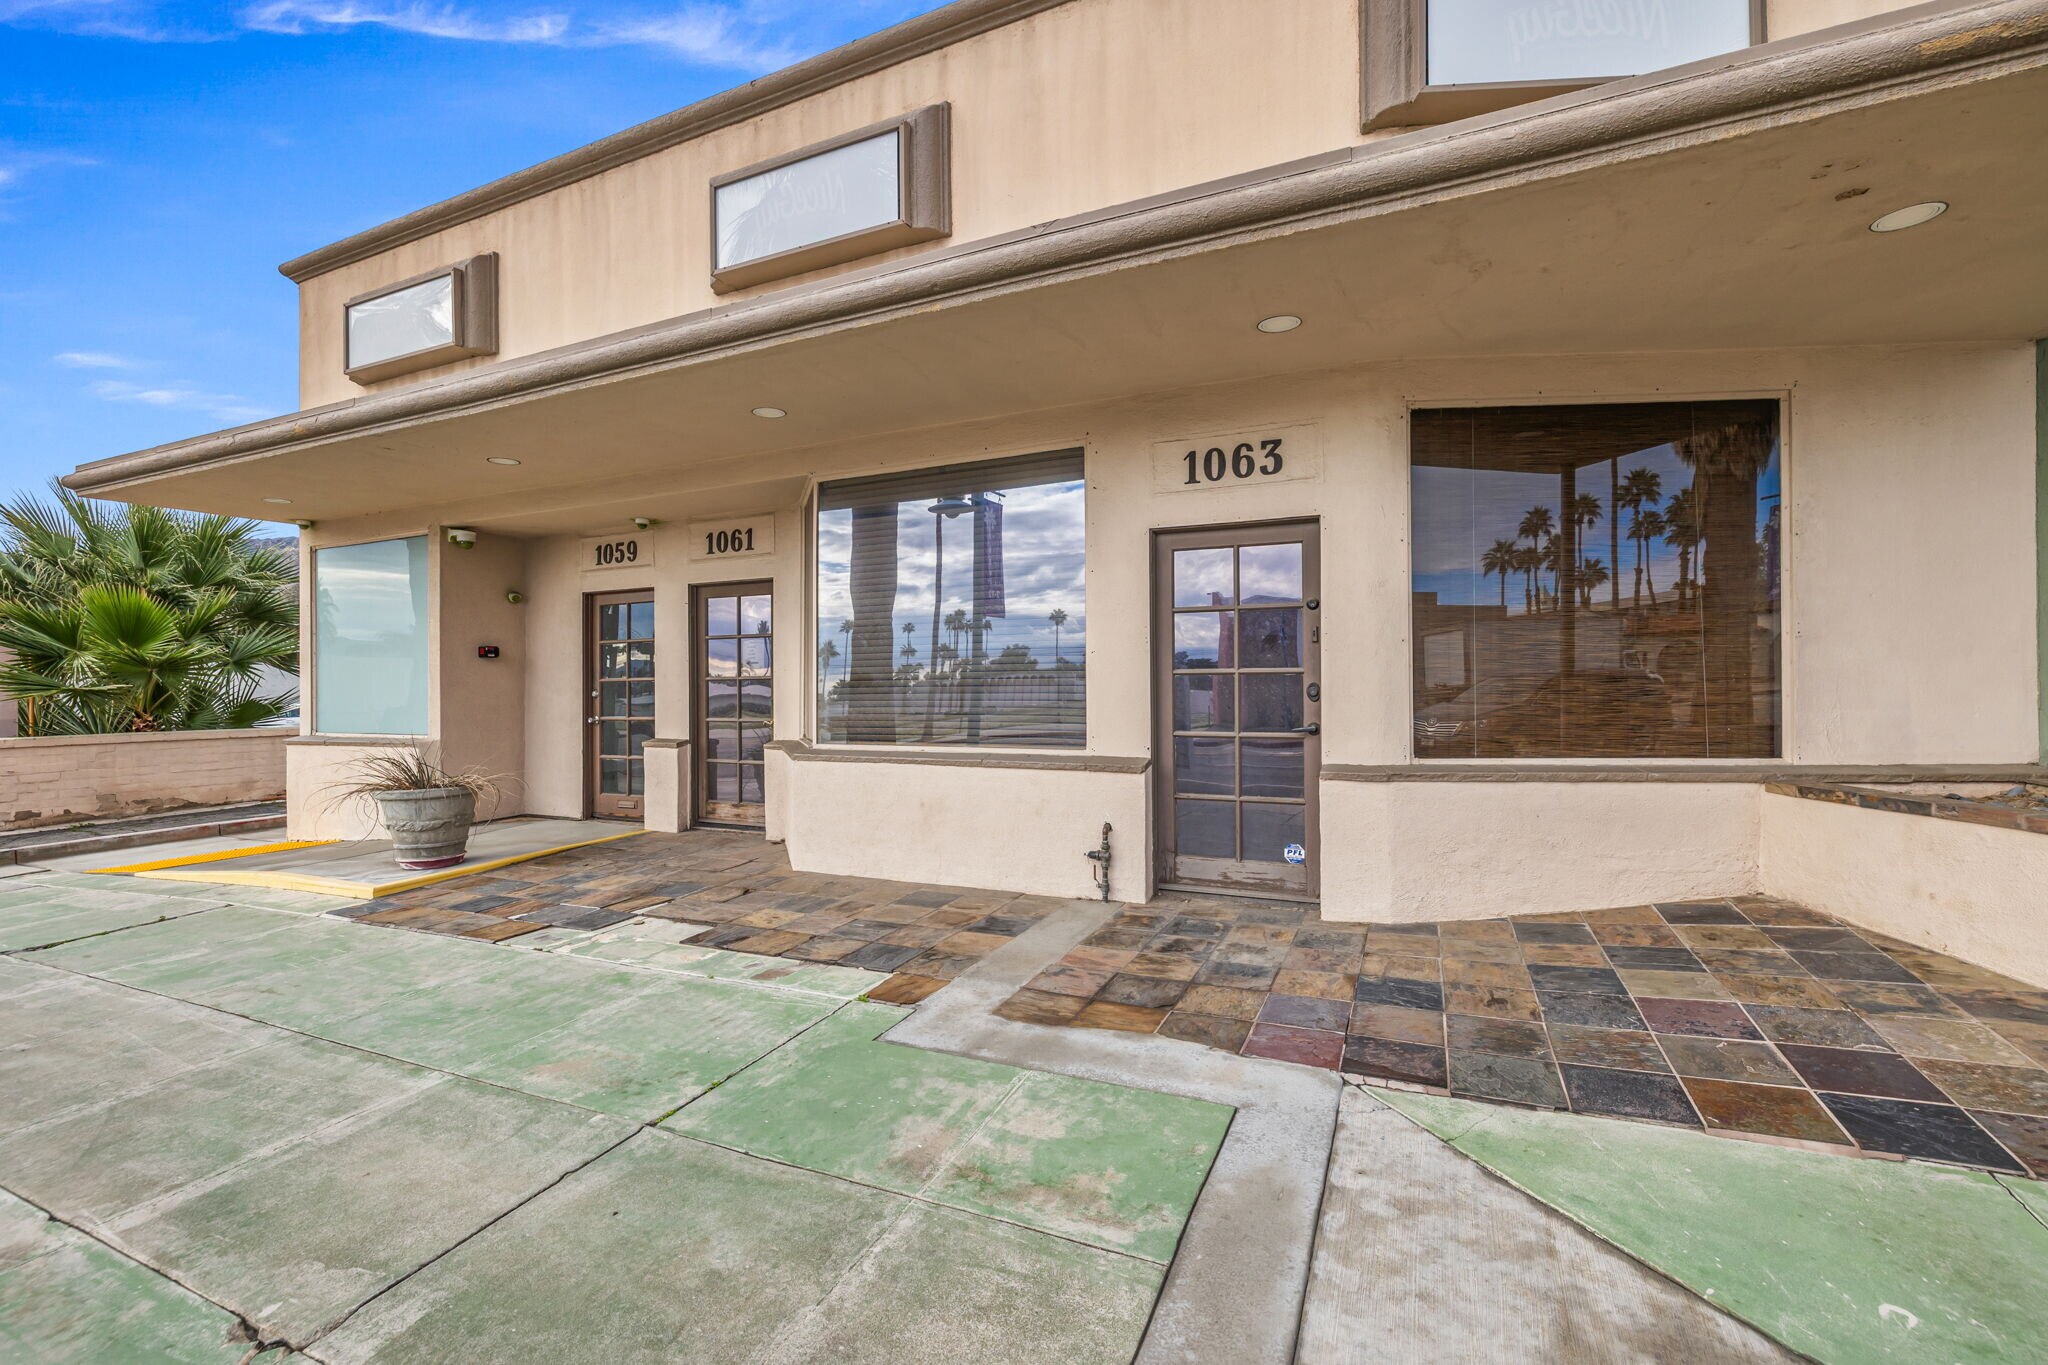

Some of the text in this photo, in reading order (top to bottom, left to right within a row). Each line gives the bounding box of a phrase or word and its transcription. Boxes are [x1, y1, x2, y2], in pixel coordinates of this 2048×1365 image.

[1183, 438, 1283, 485] 1063
[595, 540, 638, 566] 1059
[705, 527, 755, 555] 1061
